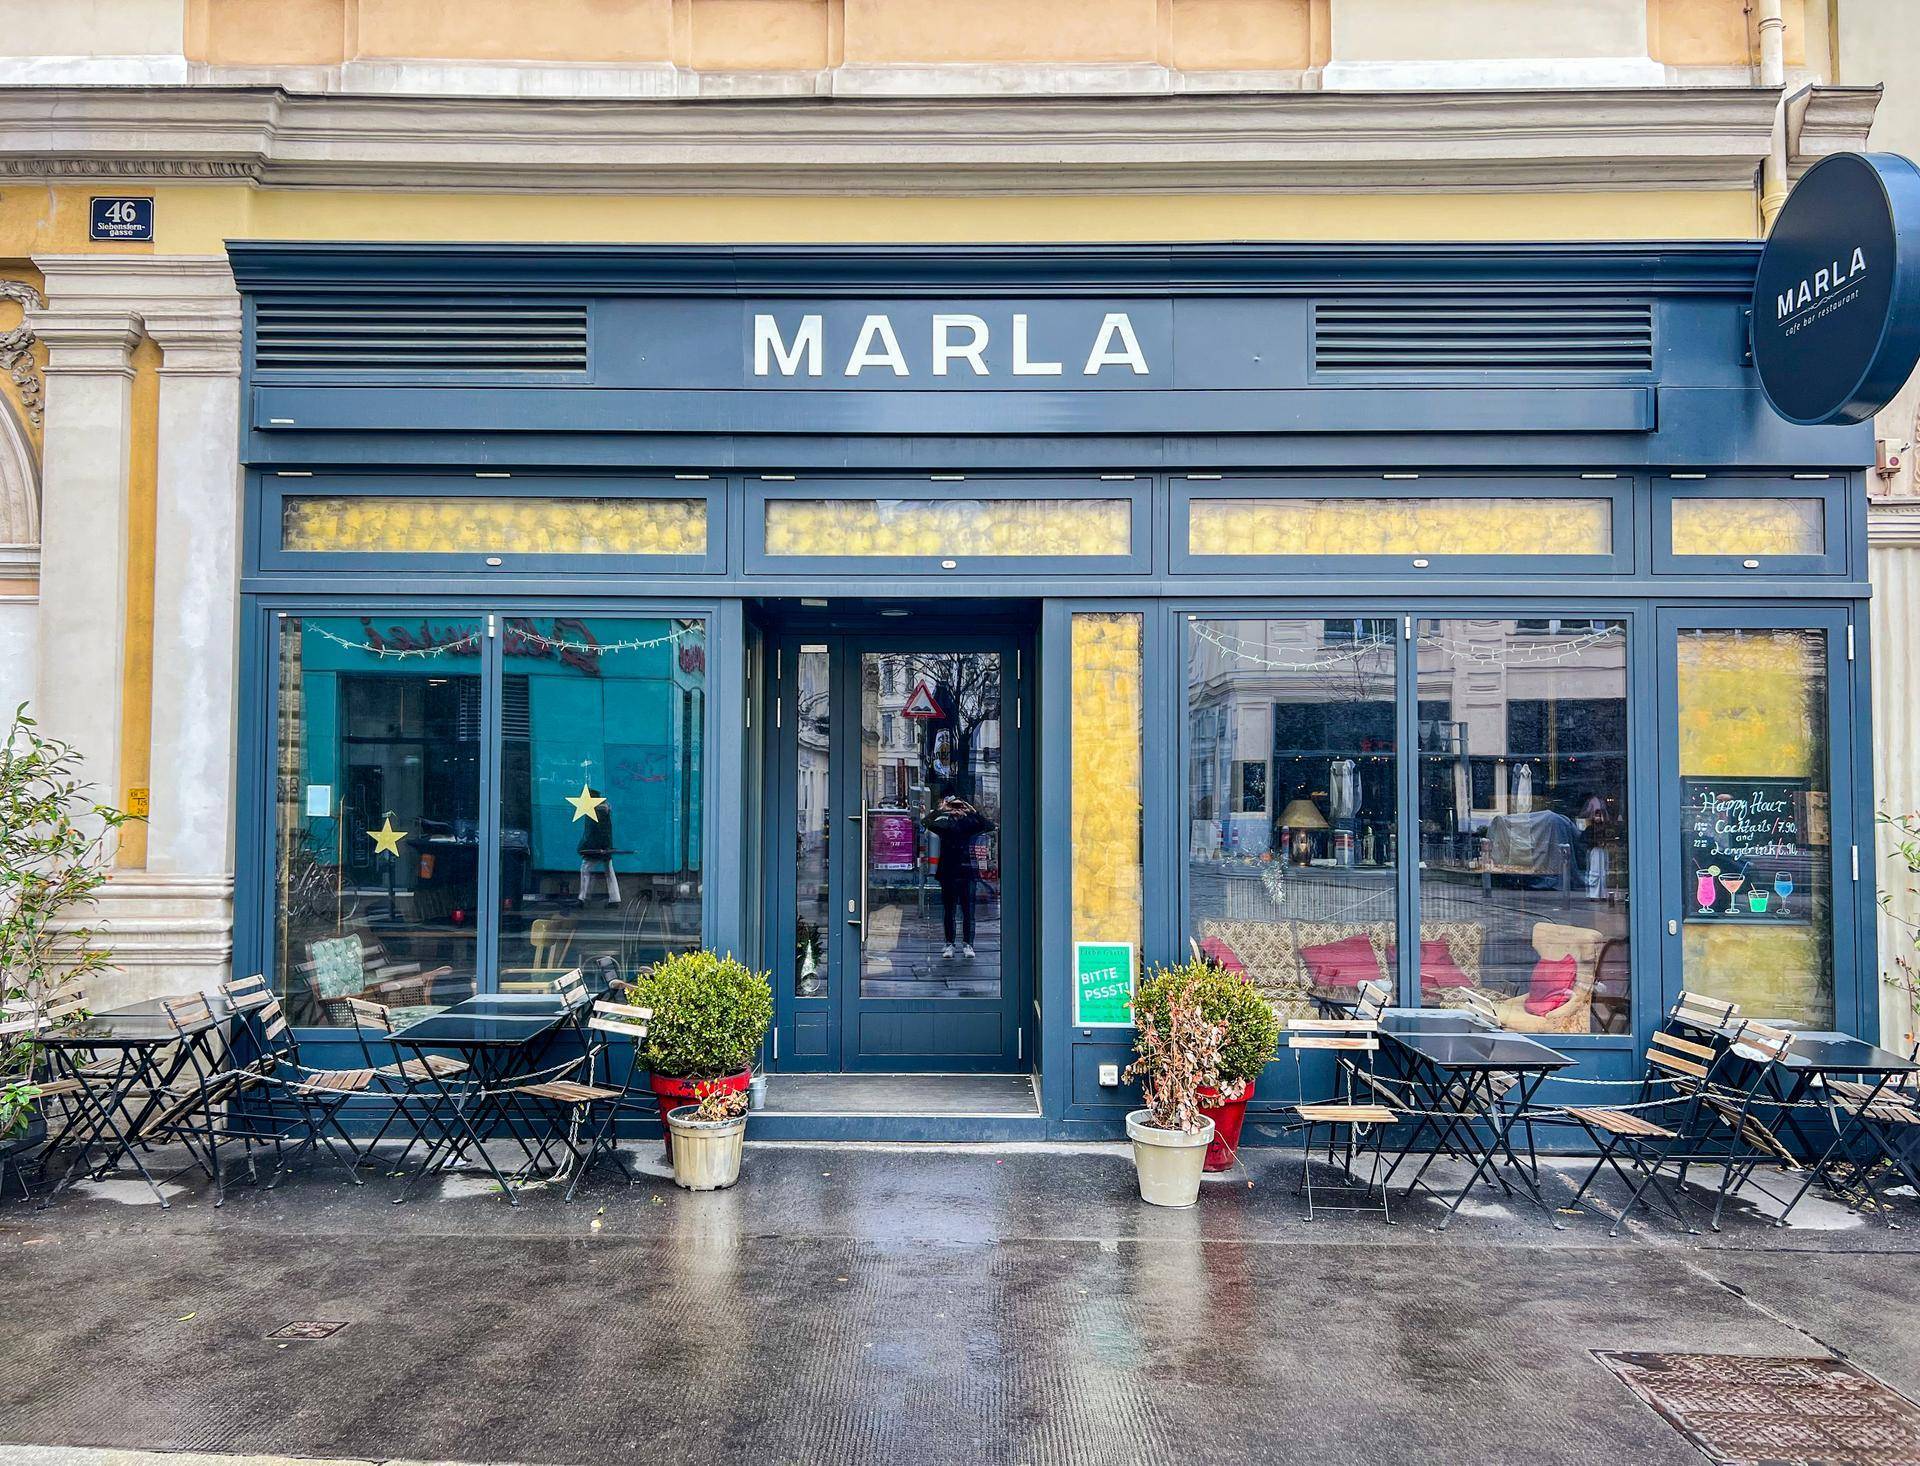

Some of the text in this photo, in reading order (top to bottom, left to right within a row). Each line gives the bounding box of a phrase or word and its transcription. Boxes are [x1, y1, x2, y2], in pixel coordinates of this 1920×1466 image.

[105, 201, 136, 222] 46
[1777, 247, 1866, 319] MARLA
[1785, 289, 1859, 336] cafe bar restaurant
[754, 313, 1150, 376] MARLA
[1700, 791, 1787, 821] Happy Hour
[1715, 819, 1771, 833] Cocktails
[1736, 832, 1754, 842] and
[1081, 967, 1119, 985] BITTE
